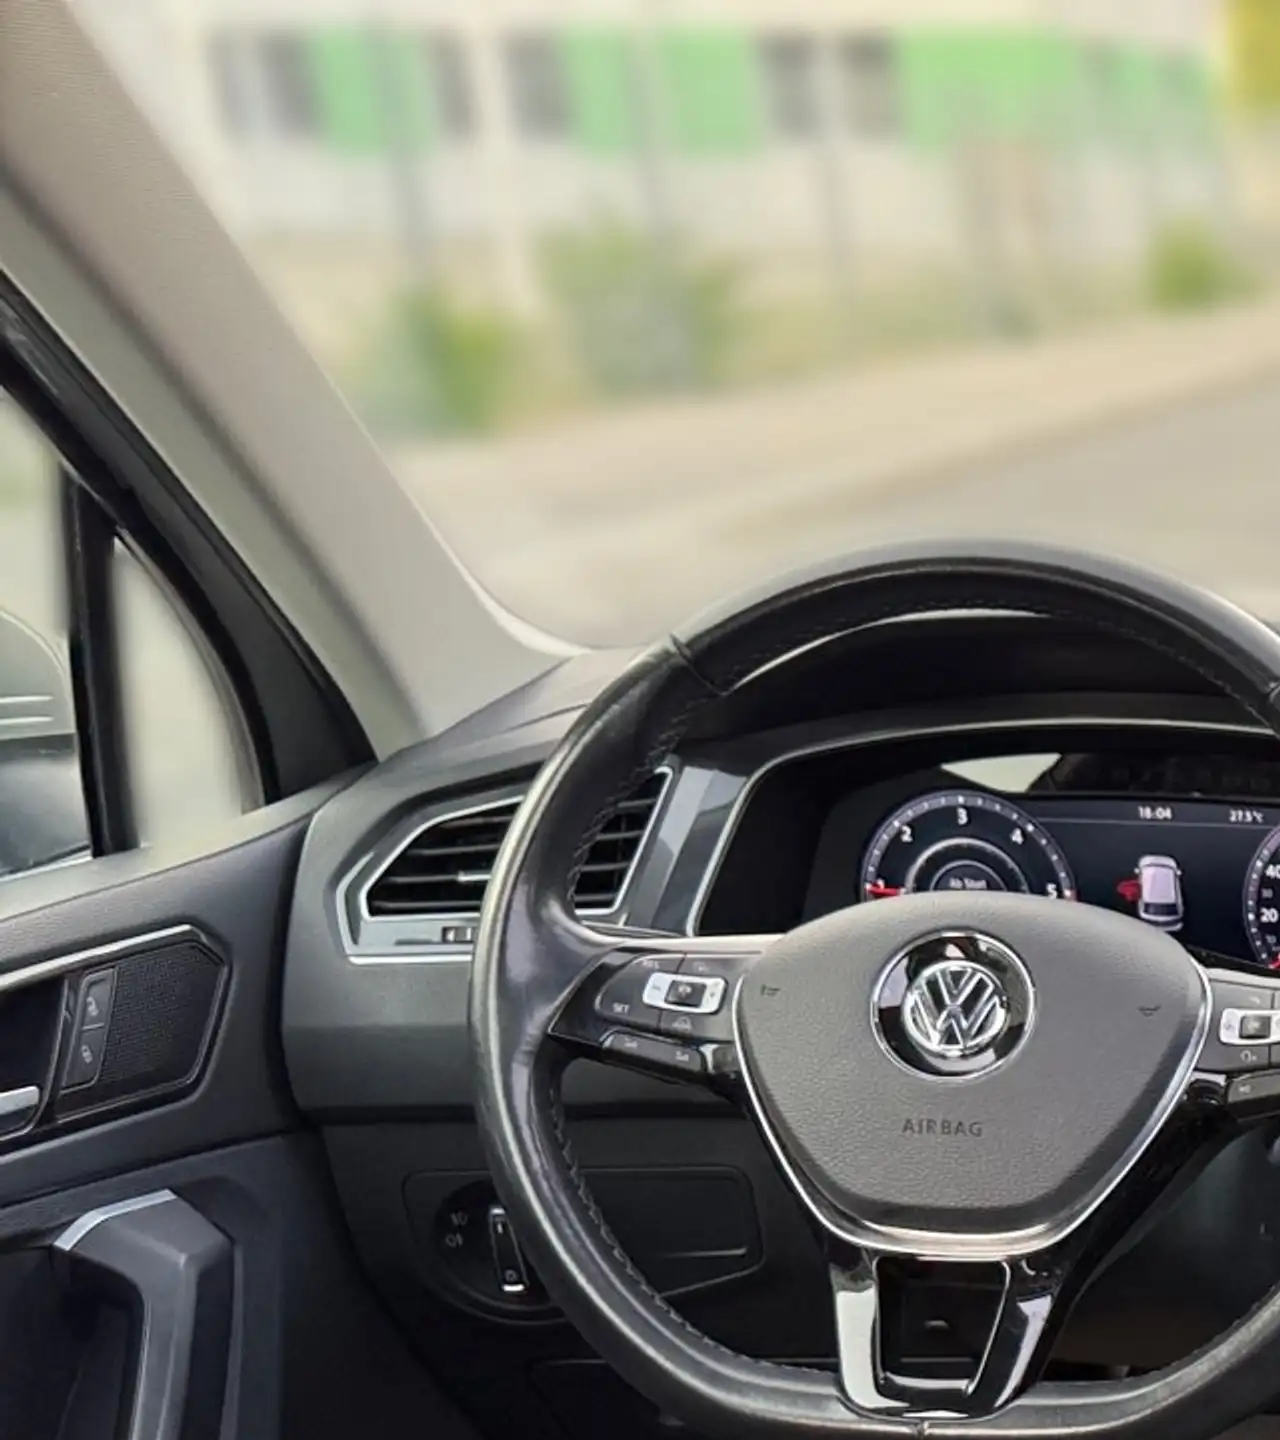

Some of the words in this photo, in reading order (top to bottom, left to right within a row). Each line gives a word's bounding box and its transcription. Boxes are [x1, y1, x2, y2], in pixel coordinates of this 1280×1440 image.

[956, 808, 967, 824] 3
[901, 826, 912, 842] 2
[1010, 828, 1023, 844] 4
[1047, 884, 1057, 900] 5
[1260, 908, 1279, 923] 20
[902, 1117, 983, 1137] AIRBAG
